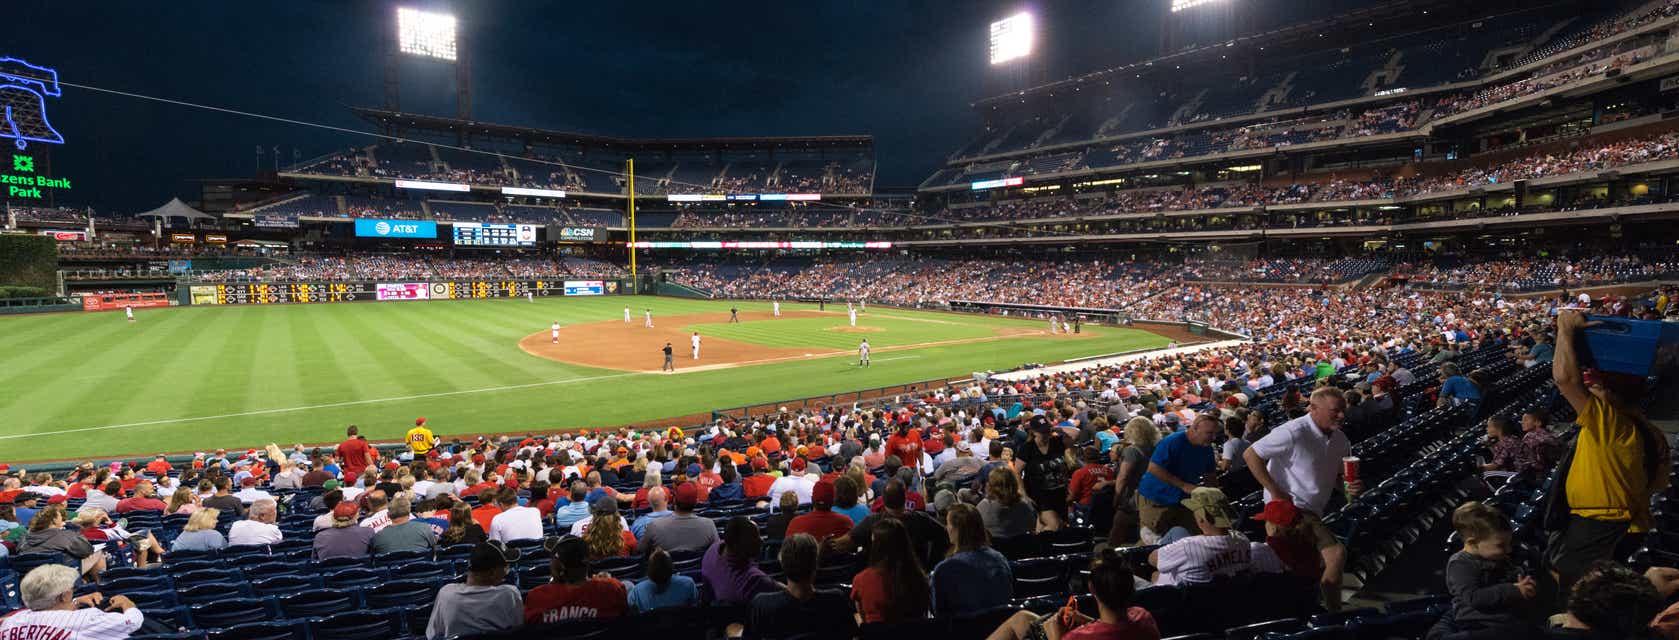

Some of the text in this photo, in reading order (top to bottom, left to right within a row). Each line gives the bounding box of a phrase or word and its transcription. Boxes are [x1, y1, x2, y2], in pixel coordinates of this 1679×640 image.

[36, 176, 72, 190] Bank
[9, 185, 42, 199] Park
[392, 224, 419, 234] AT&T
[573, 228, 594, 237] CSN
